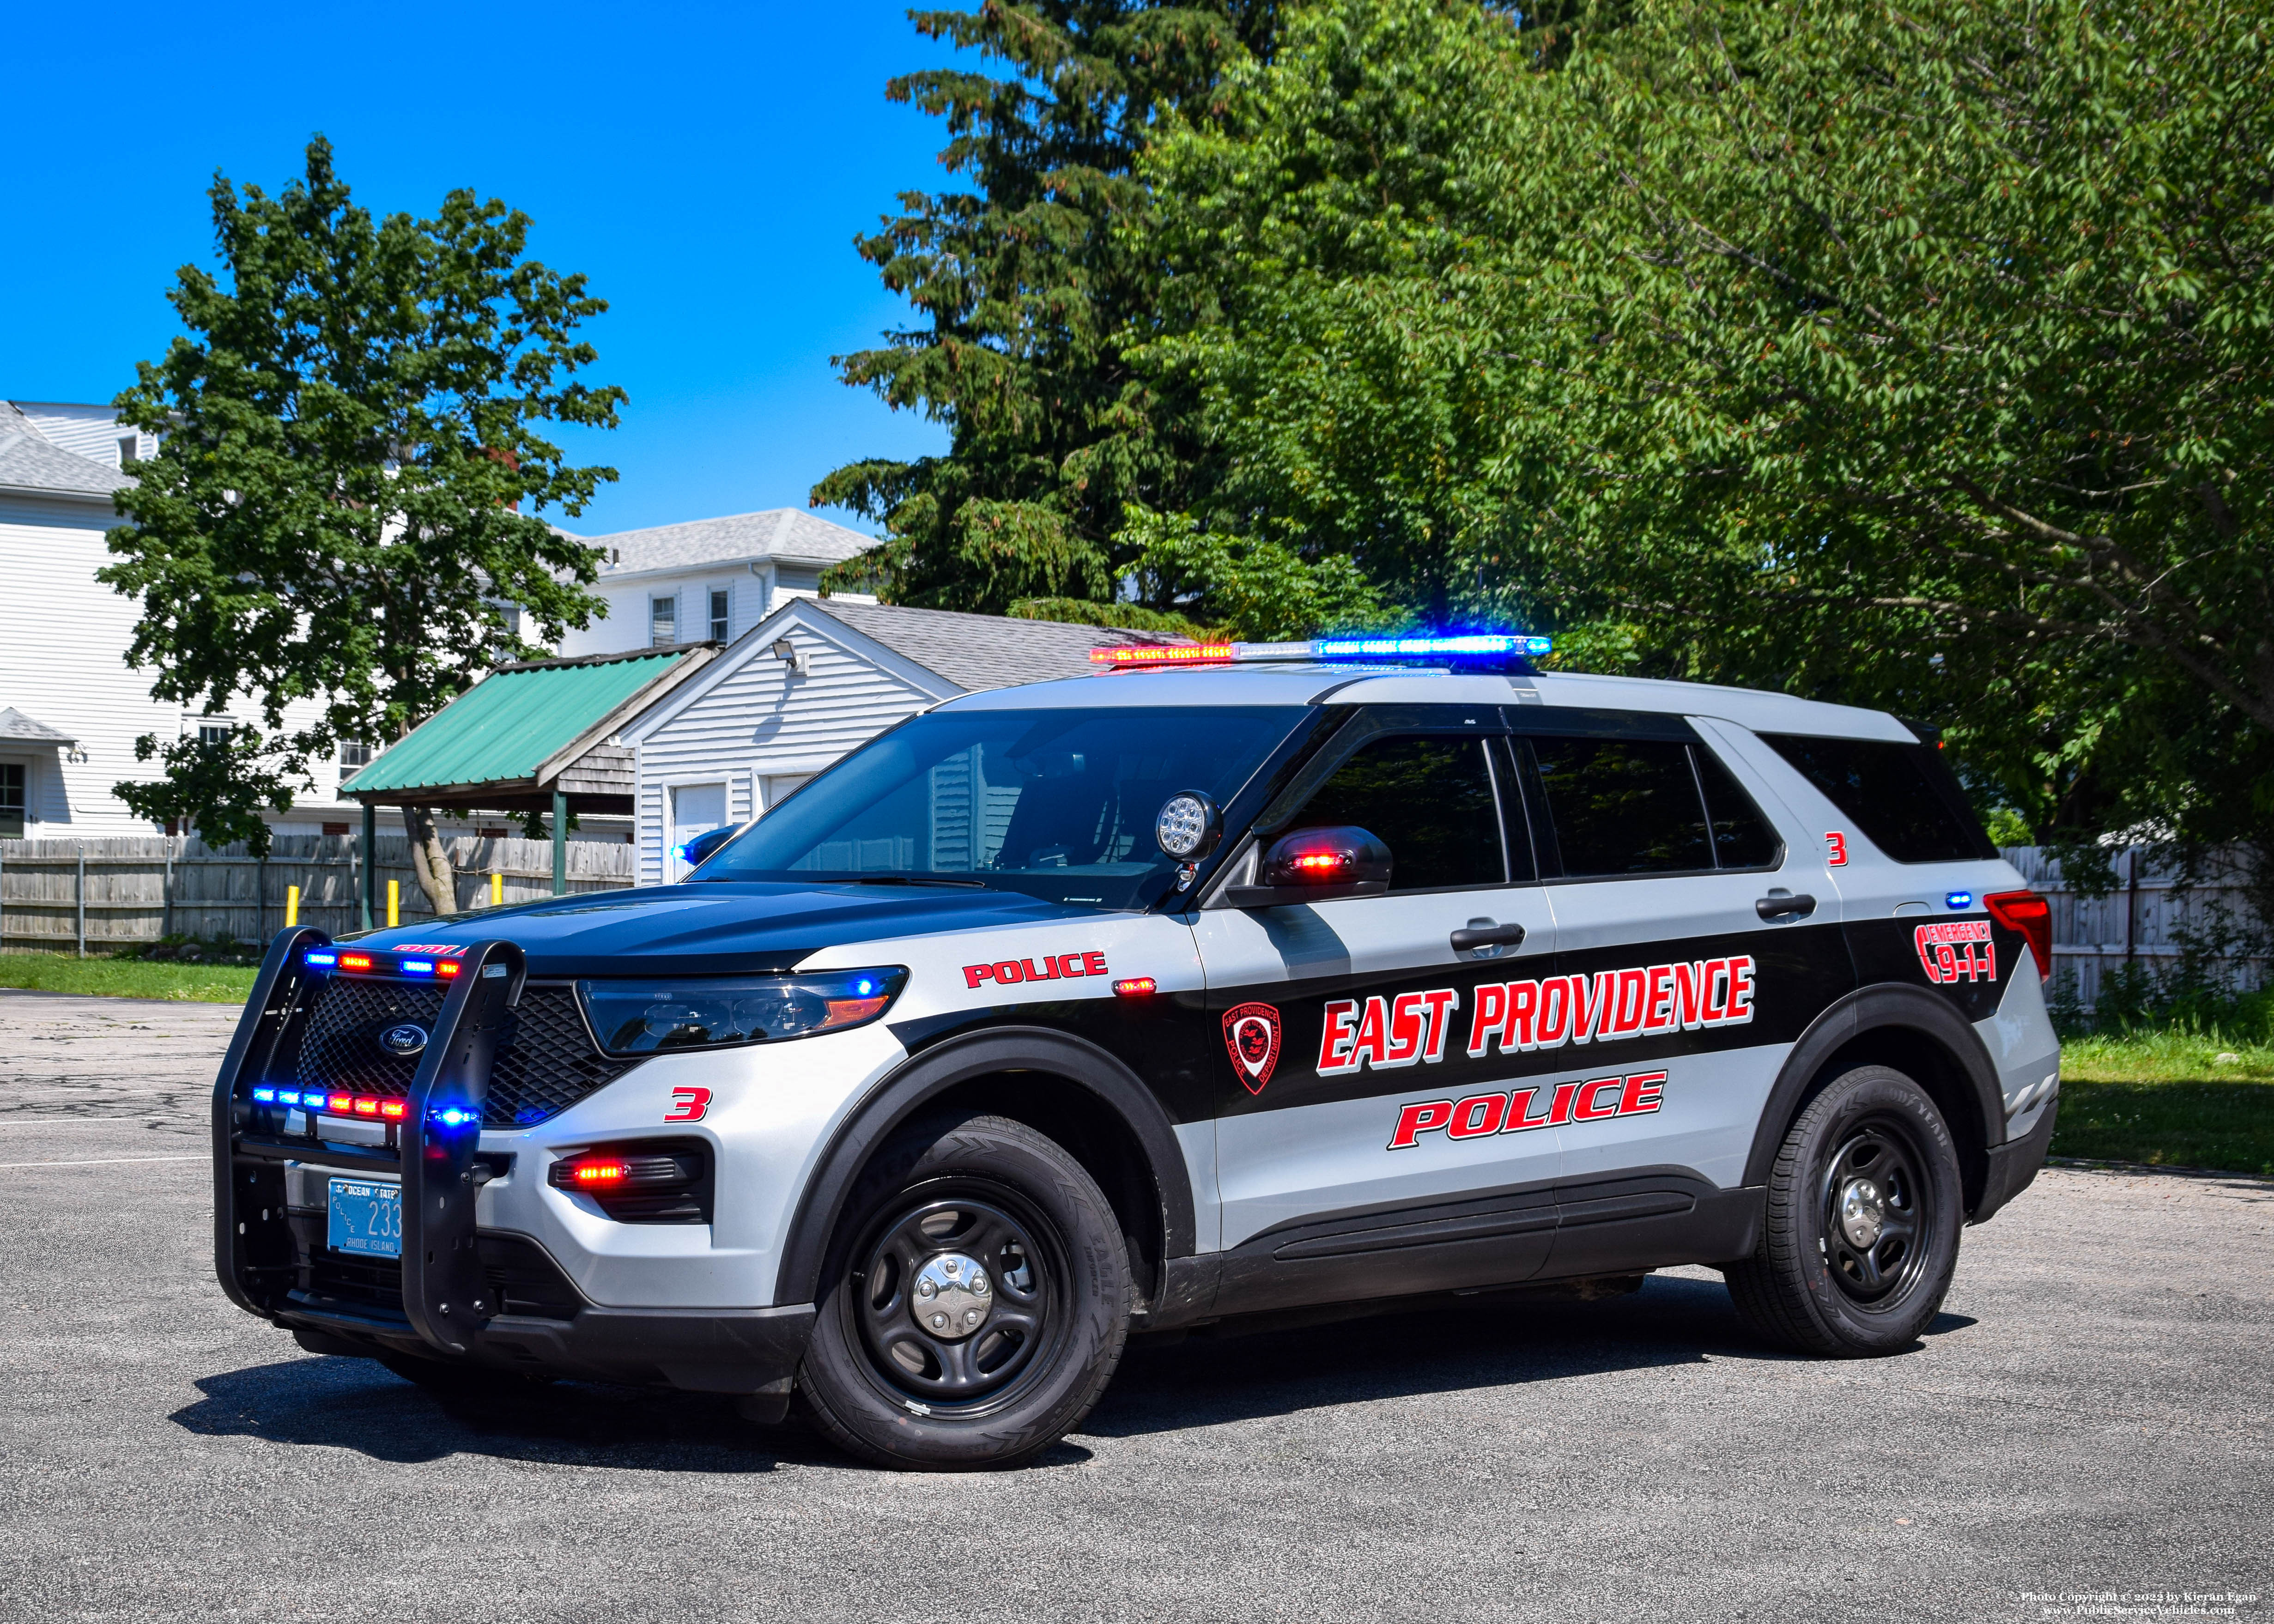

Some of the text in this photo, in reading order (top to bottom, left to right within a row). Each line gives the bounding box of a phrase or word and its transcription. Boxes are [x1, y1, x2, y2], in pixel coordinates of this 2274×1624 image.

[1825, 831, 1849, 867] 3
[1926, 920, 1992, 945] EMERGENCY
[962, 951, 1108, 989] POLICE
[1934, 941, 1996, 983] 9-1-1
[1225, 1006, 1277, 1027] EAST PROVIDENCE
[1240, 1021, 1266, 1039] RHODE ISLAND
[1315, 955, 1756, 1076] EAST PROVIDENCE
[389, 1030, 415, 1047] Ford
[1259, 1024, 1279, 1083] DEPARTMENT
[1229, 1040, 1246, 1076] POLICE
[663, 1085, 713, 1123] 3
[1385, 1070, 1668, 1151] POLICE
[348, 1185, 370, 1197] OCEAN
[333, 1196, 355, 1233] POLICE
[368, 1201, 402, 1238] 233
[347, 1237, 394, 1252] RHODE ISLAND
[1087, 1232, 1114, 1308] EAGLE
